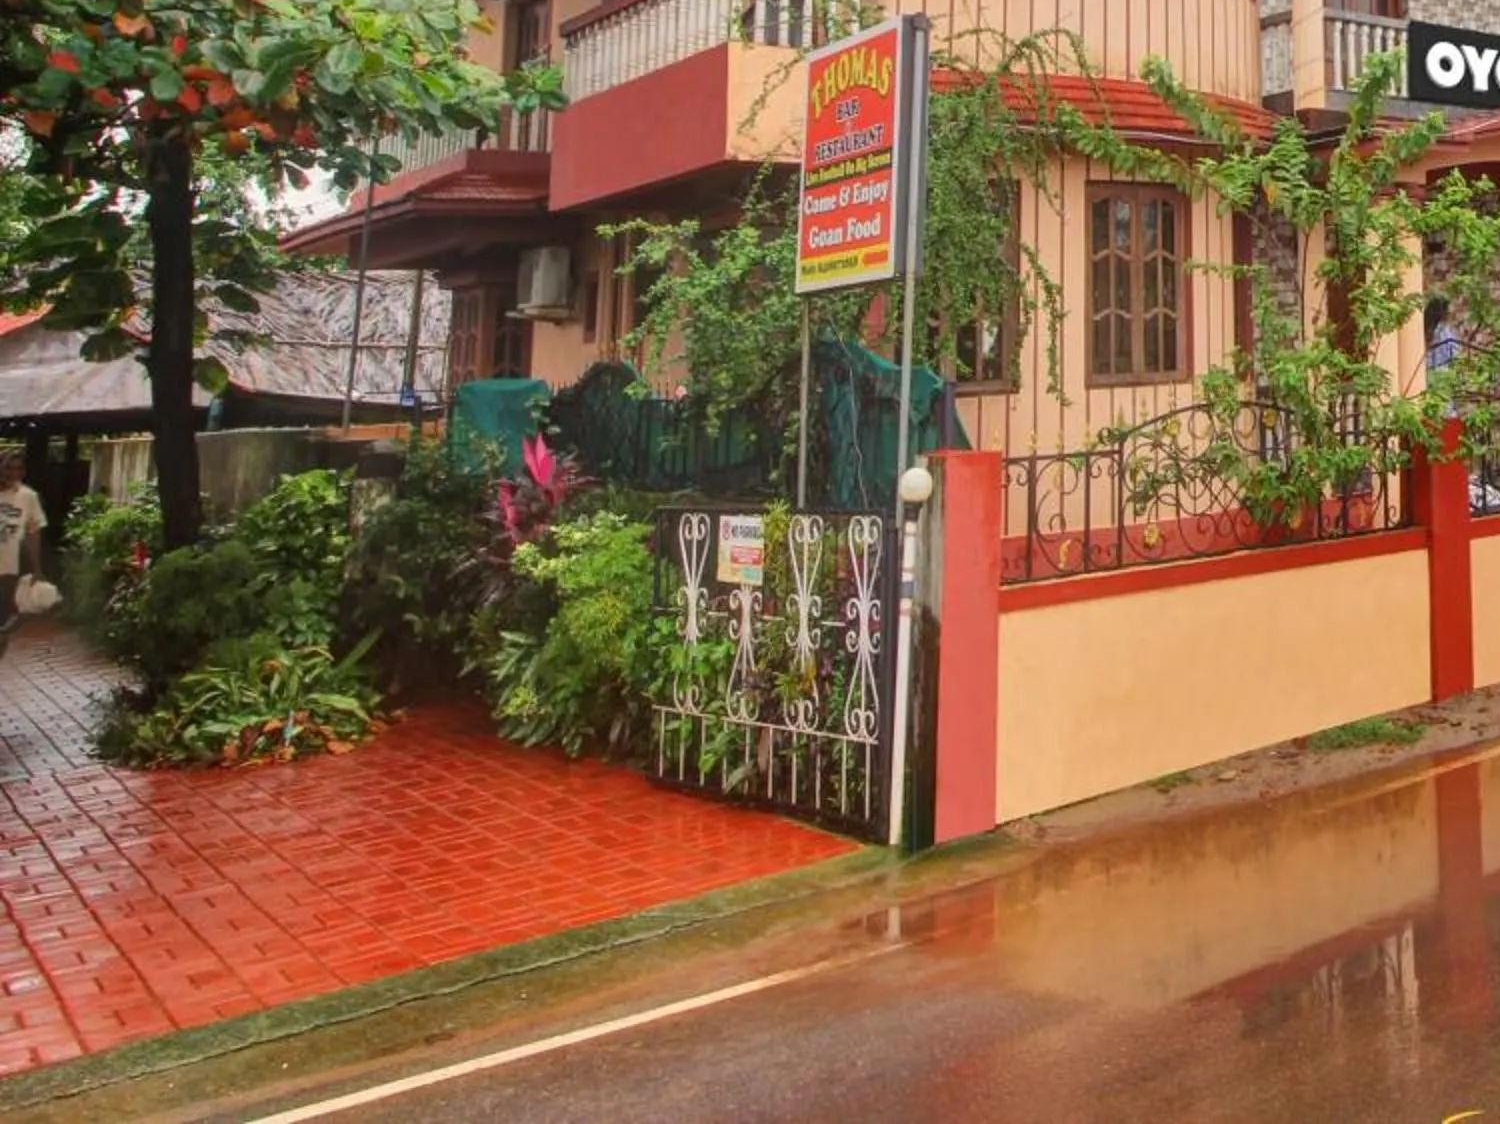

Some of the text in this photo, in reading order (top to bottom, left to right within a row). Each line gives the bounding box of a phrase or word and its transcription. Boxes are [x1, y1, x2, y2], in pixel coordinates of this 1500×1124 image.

[811, 47, 892, 118] THOMAS
[835, 96, 860, 122] BAR
[815, 124, 883, 162] RESTAURANT
[804, 179, 889, 215] Come & Enjoy
[809, 212, 881, 249] Goan Food
